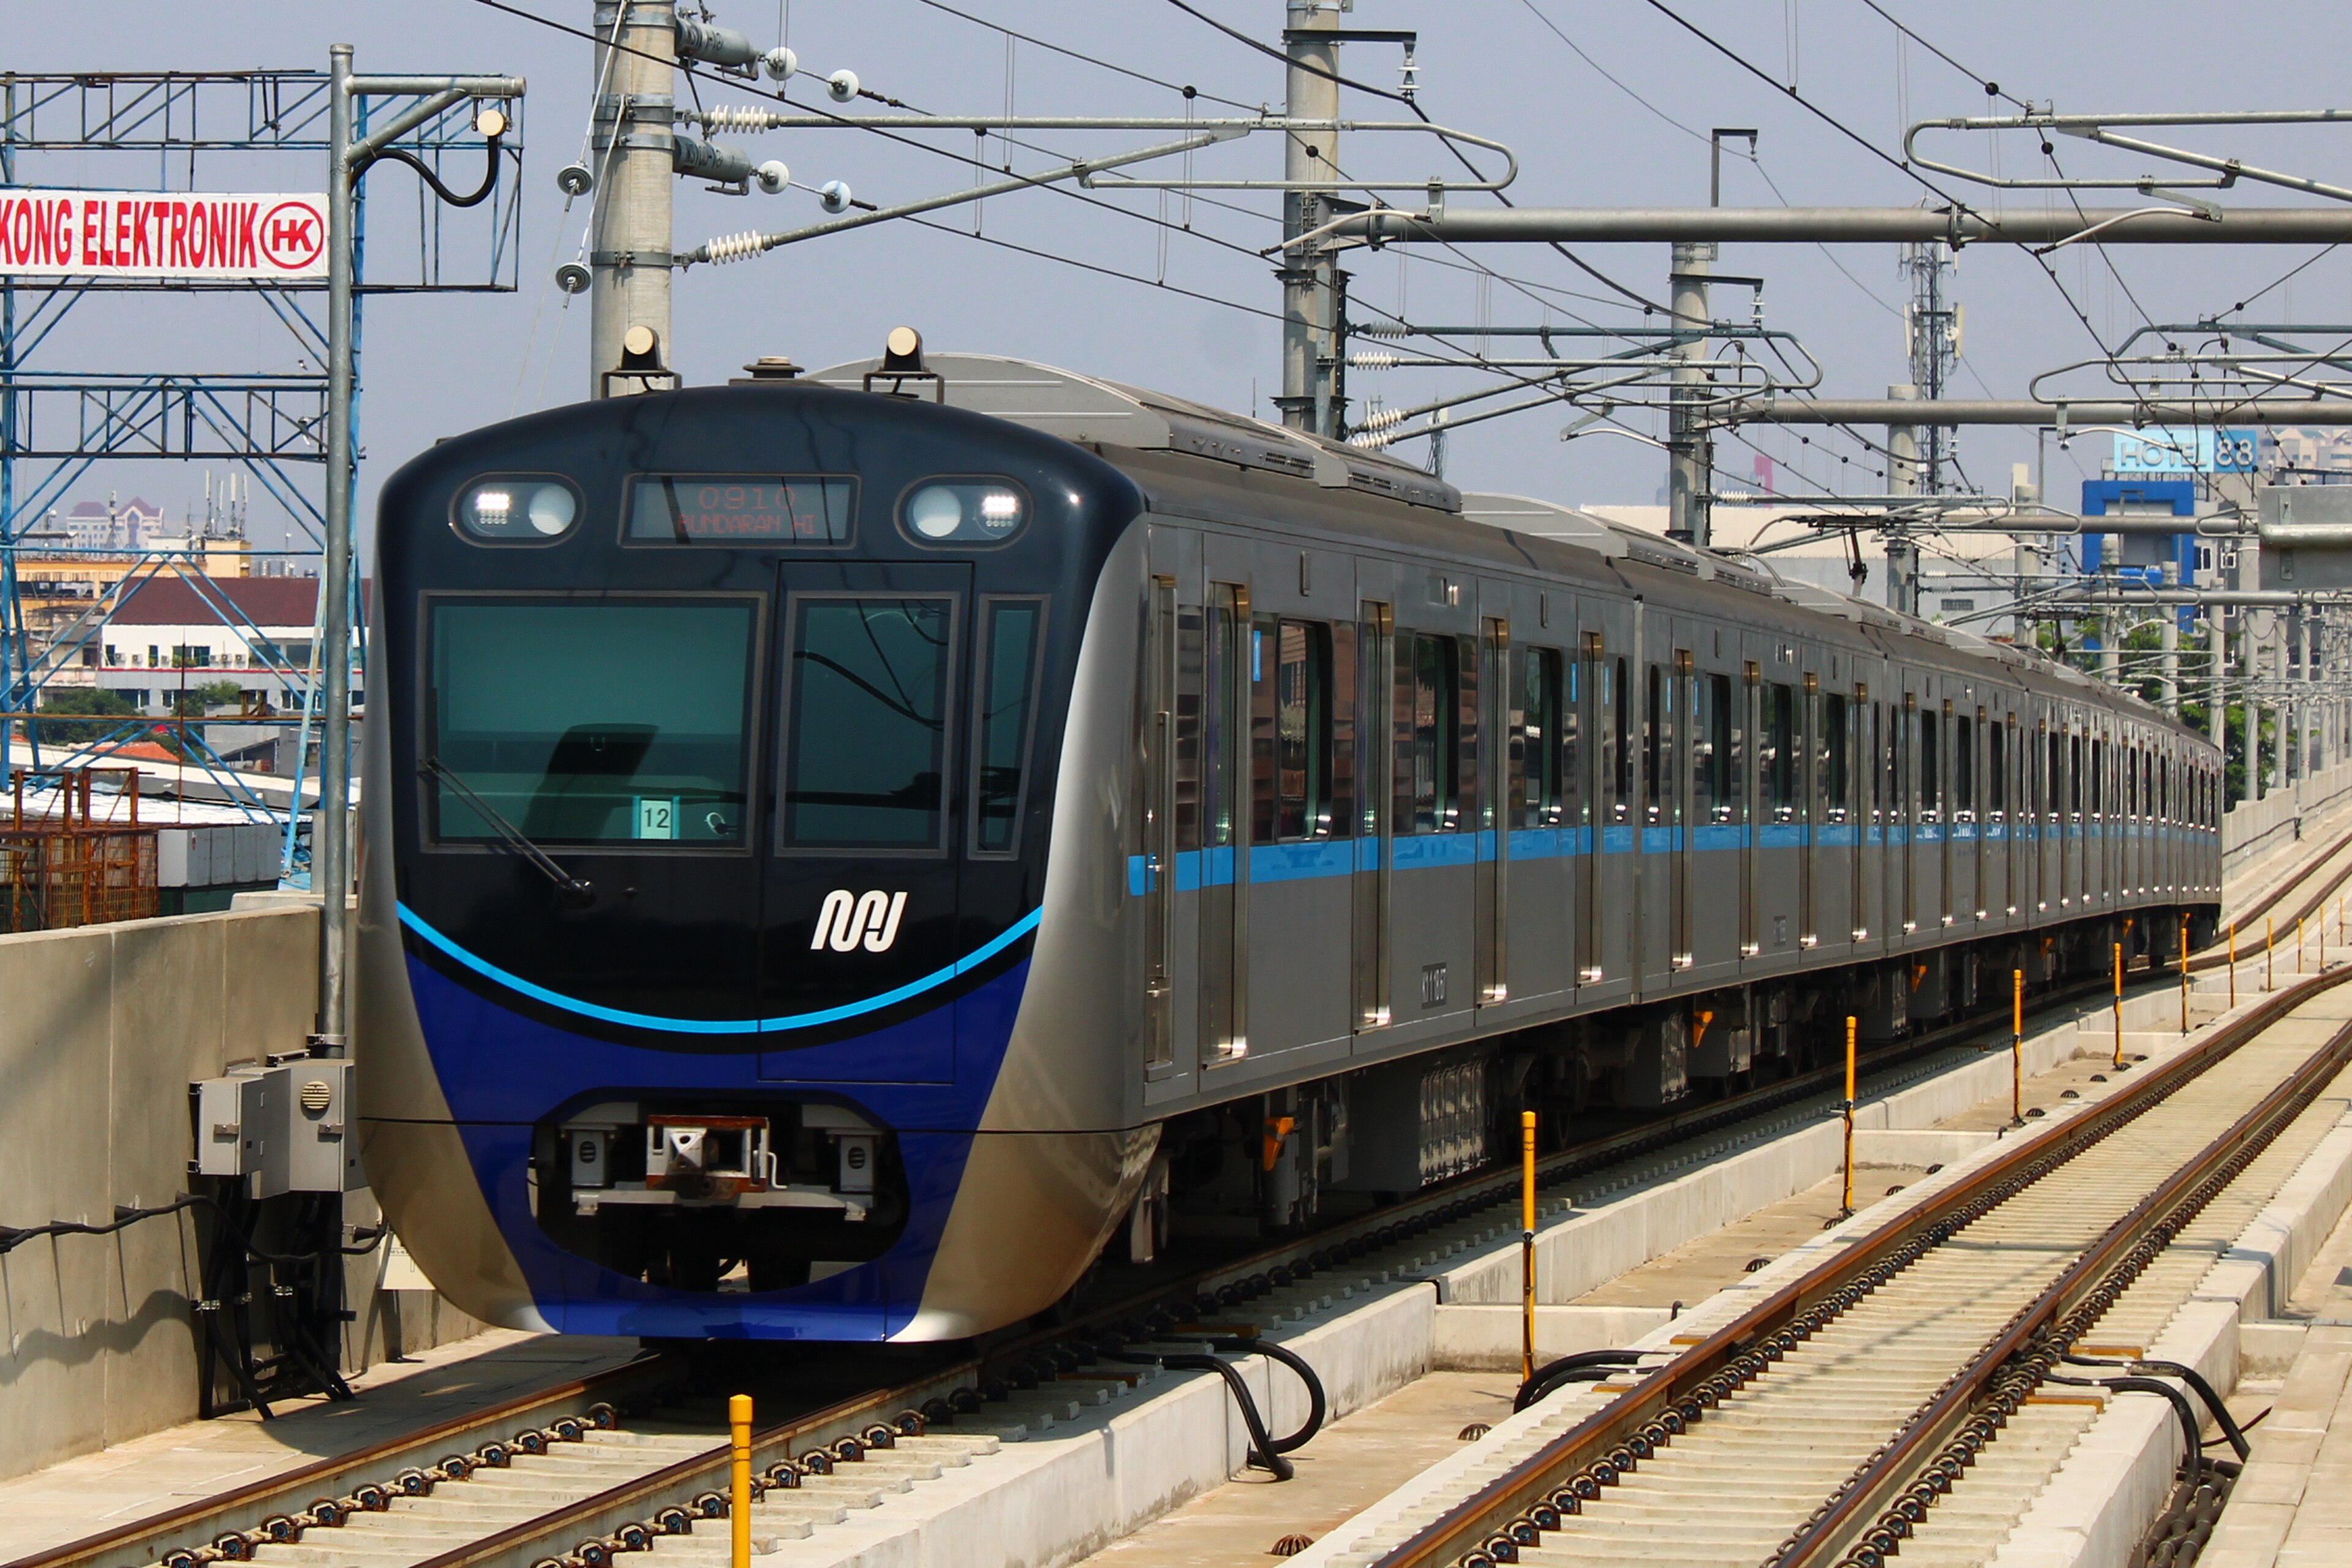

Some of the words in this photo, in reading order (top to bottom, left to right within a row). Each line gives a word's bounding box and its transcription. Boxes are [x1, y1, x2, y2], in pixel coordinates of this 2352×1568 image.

[0, 198, 72, 266] KONG
[82, 200, 259, 268] ELEKTRONIK
[271, 218, 314, 252] HK
[2120, 442, 2207, 467] HOTEL
[2216, 438, 2254, 467] 88
[699, 486, 796, 510] 0910
[678, 514, 781, 534] BUNDARAN
[644, 807, 669, 828] 12
